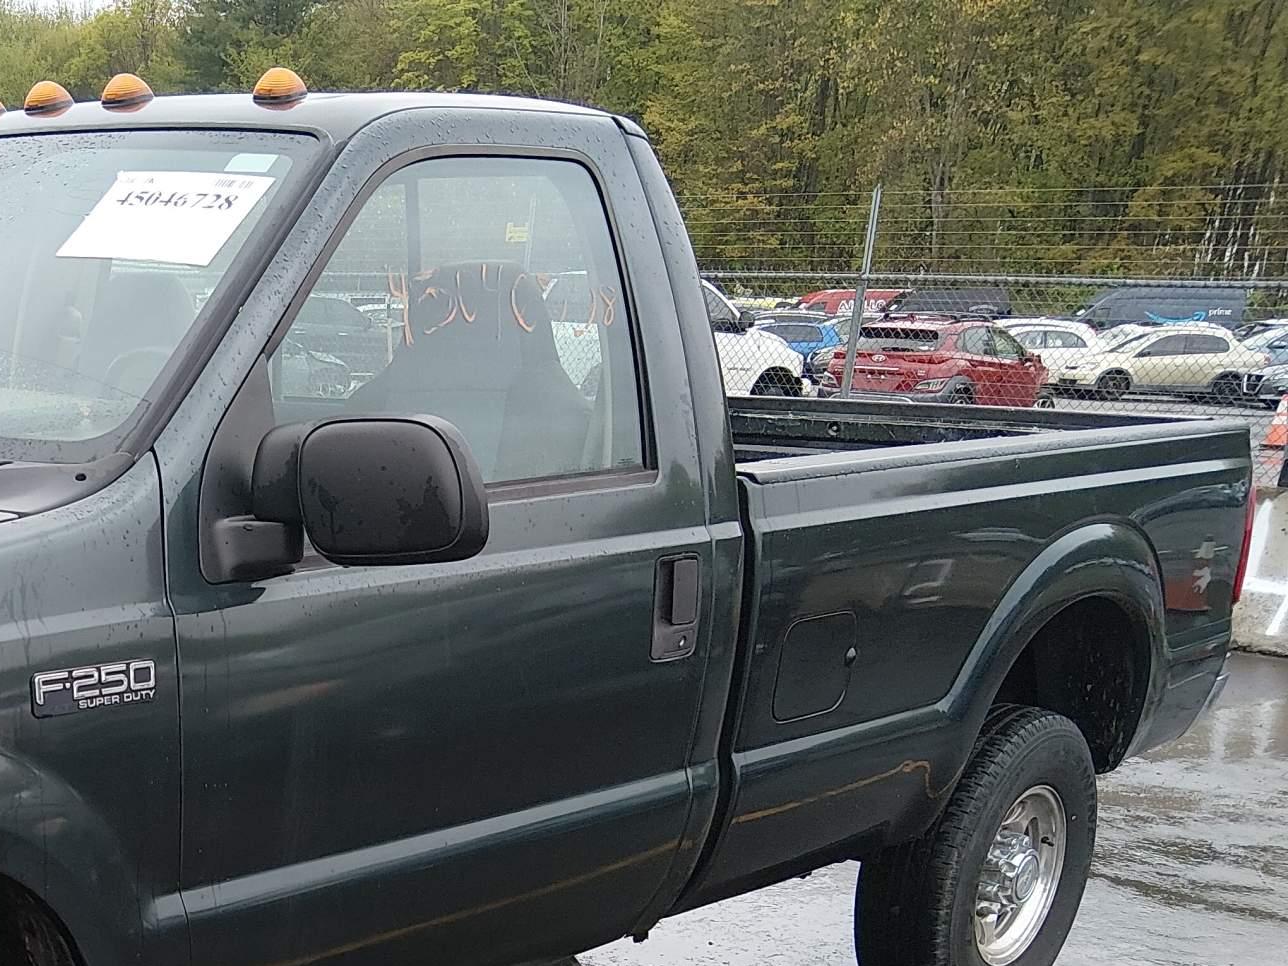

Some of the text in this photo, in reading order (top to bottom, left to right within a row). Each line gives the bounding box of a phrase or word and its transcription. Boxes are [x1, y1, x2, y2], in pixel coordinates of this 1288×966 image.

[116, 190, 239, 211] 45046728
[1208, 307, 1232, 317] prime
[78, 689, 155, 709] SUPER DUTY
